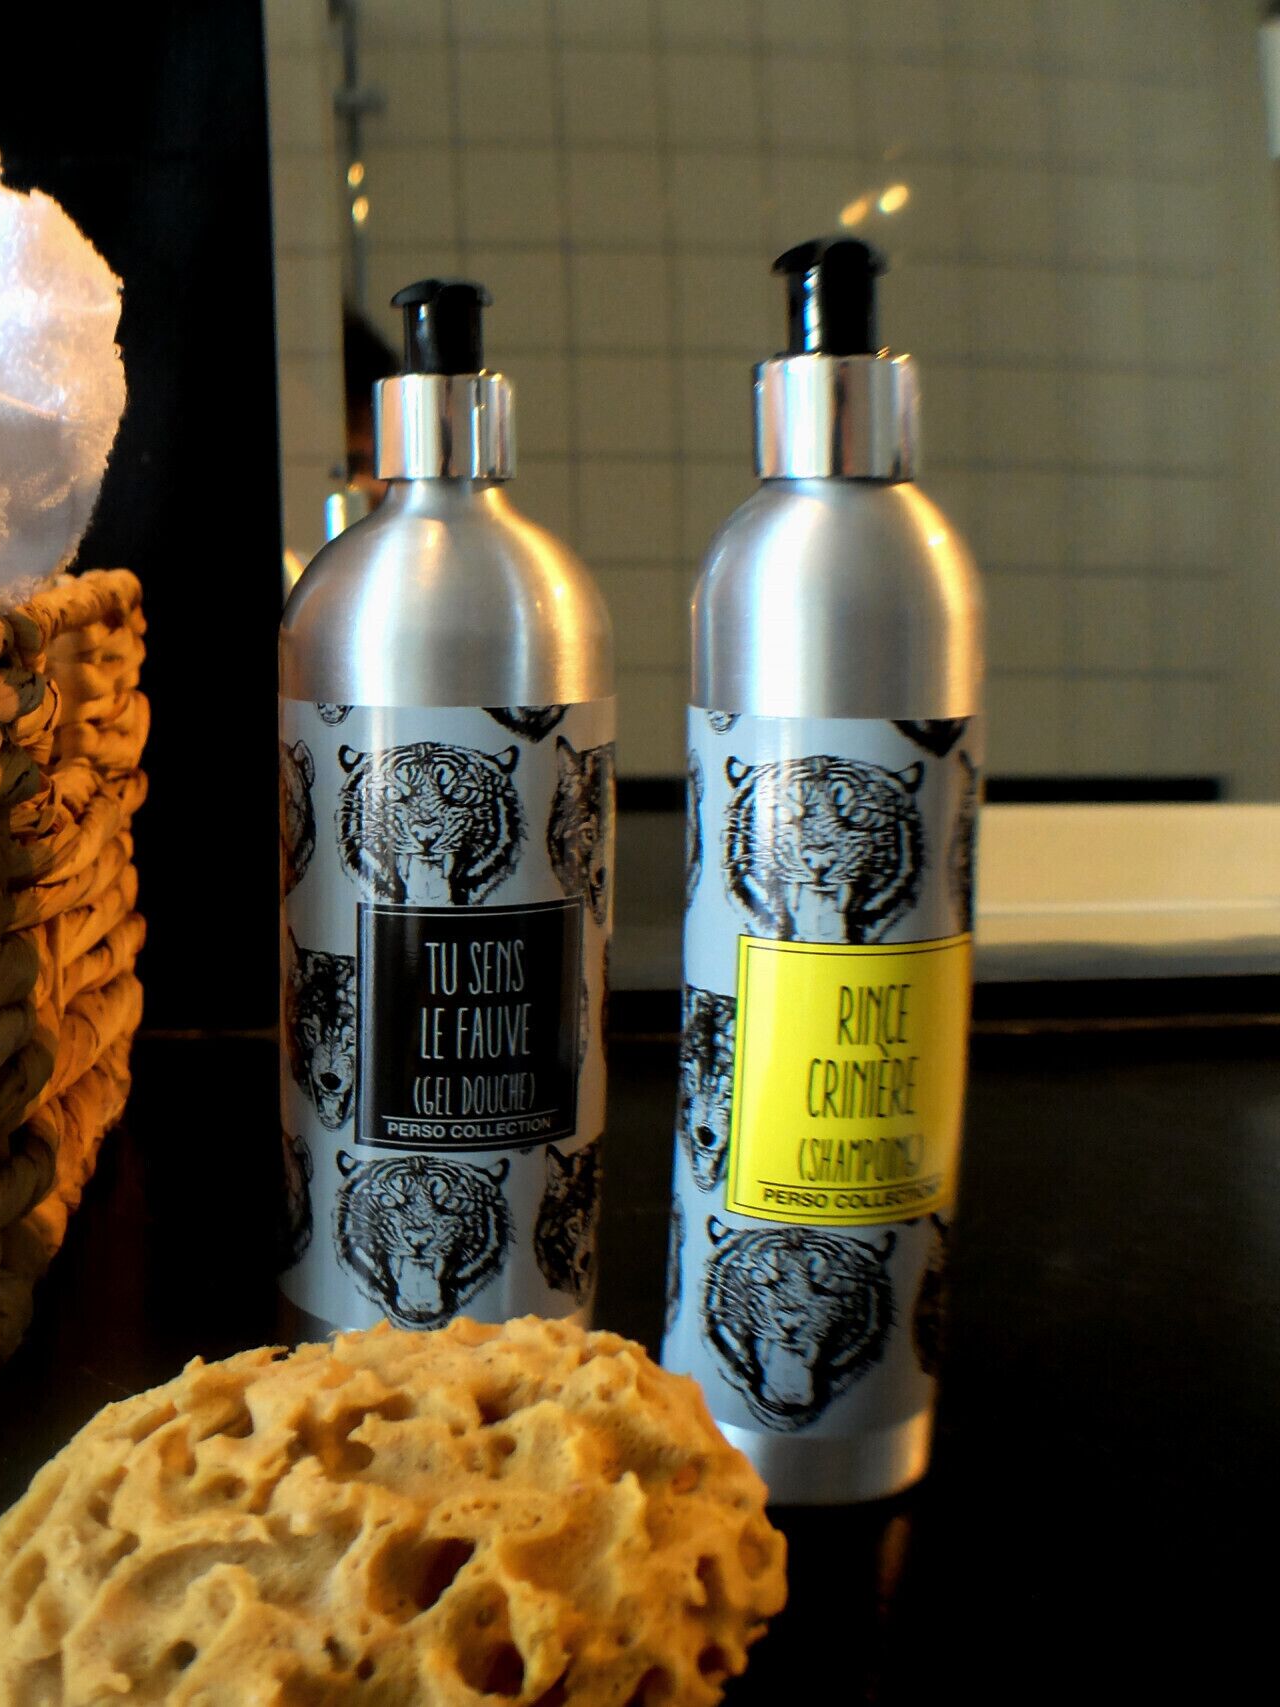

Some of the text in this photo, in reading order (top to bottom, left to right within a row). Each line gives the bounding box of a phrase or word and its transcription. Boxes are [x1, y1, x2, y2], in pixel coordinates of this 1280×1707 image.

[424, 939, 525, 996] TU SENS
[420, 1003, 532, 1060] LE FAUVE
[837, 983, 912, 1046] RINCE
[412, 1072, 535, 1116] (GEL DOUCHE)
[387, 1116, 552, 1139] PERSO COLLECTION
[763, 1186, 829, 1209] PERSO
